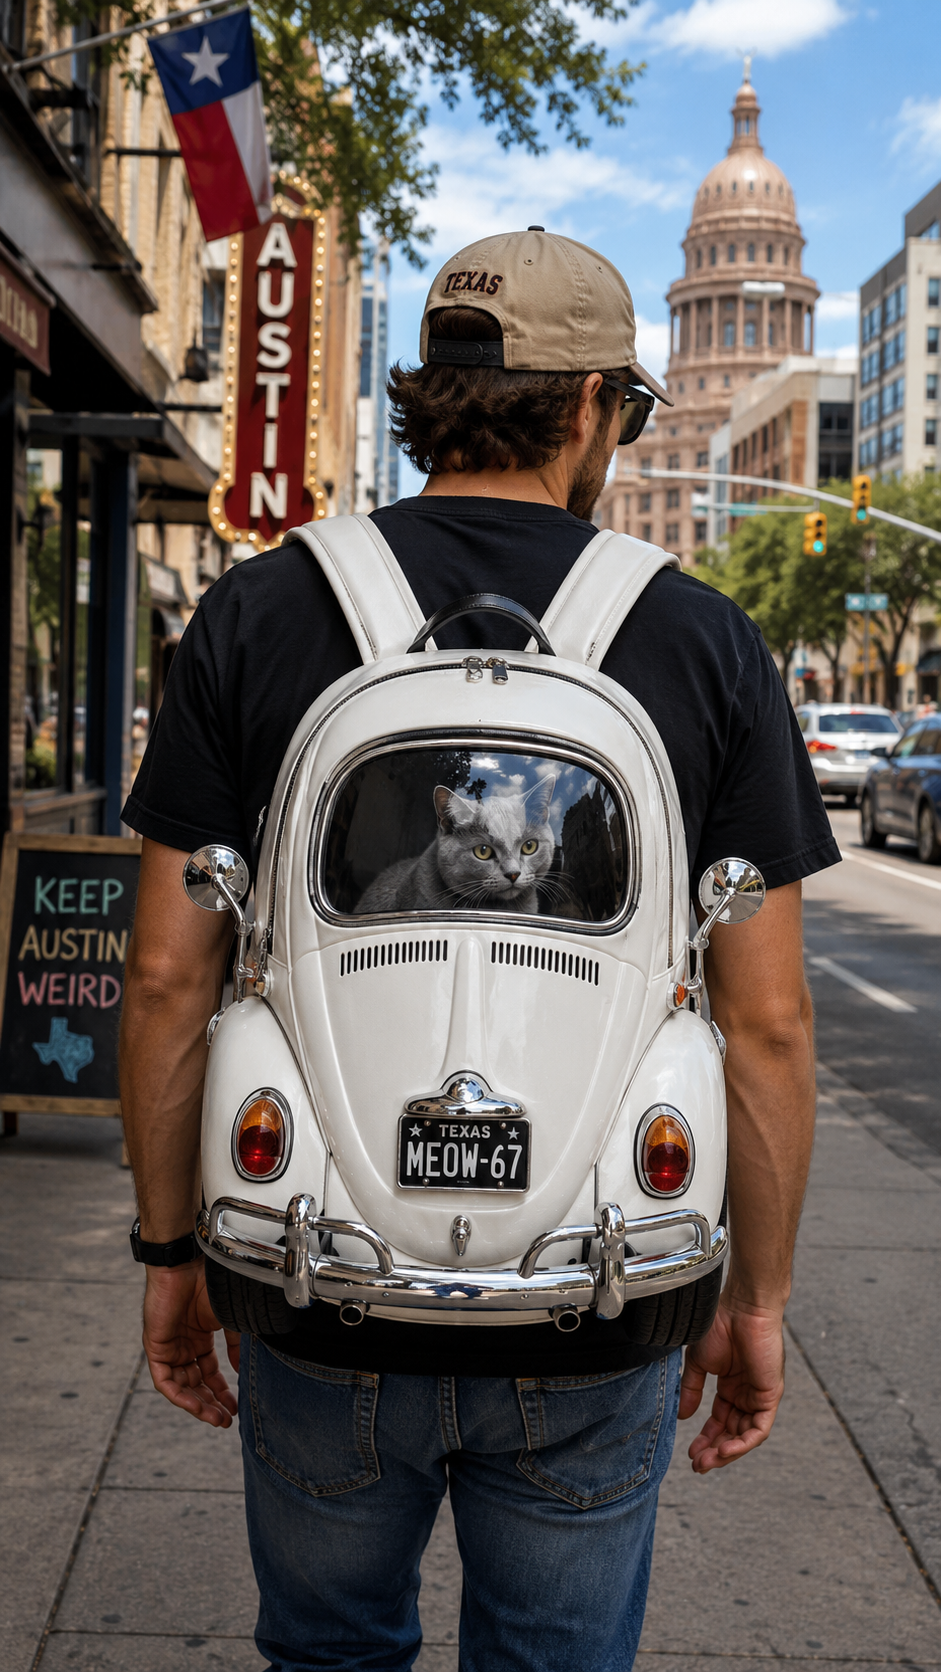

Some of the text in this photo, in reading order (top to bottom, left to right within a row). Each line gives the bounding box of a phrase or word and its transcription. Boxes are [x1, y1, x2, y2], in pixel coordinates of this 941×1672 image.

[444, 271, 503, 295] TEXAS
[249, 222, 298, 519] AUSTIN
[34, 876, 124, 916] KEEP
[18, 924, 128, 963] AUSTIN
[18, 971, 121, 1009] WEIRD
[439, 1124, 491, 1139] TEXAS
[406, 1141, 523, 1179] MEOW-67
